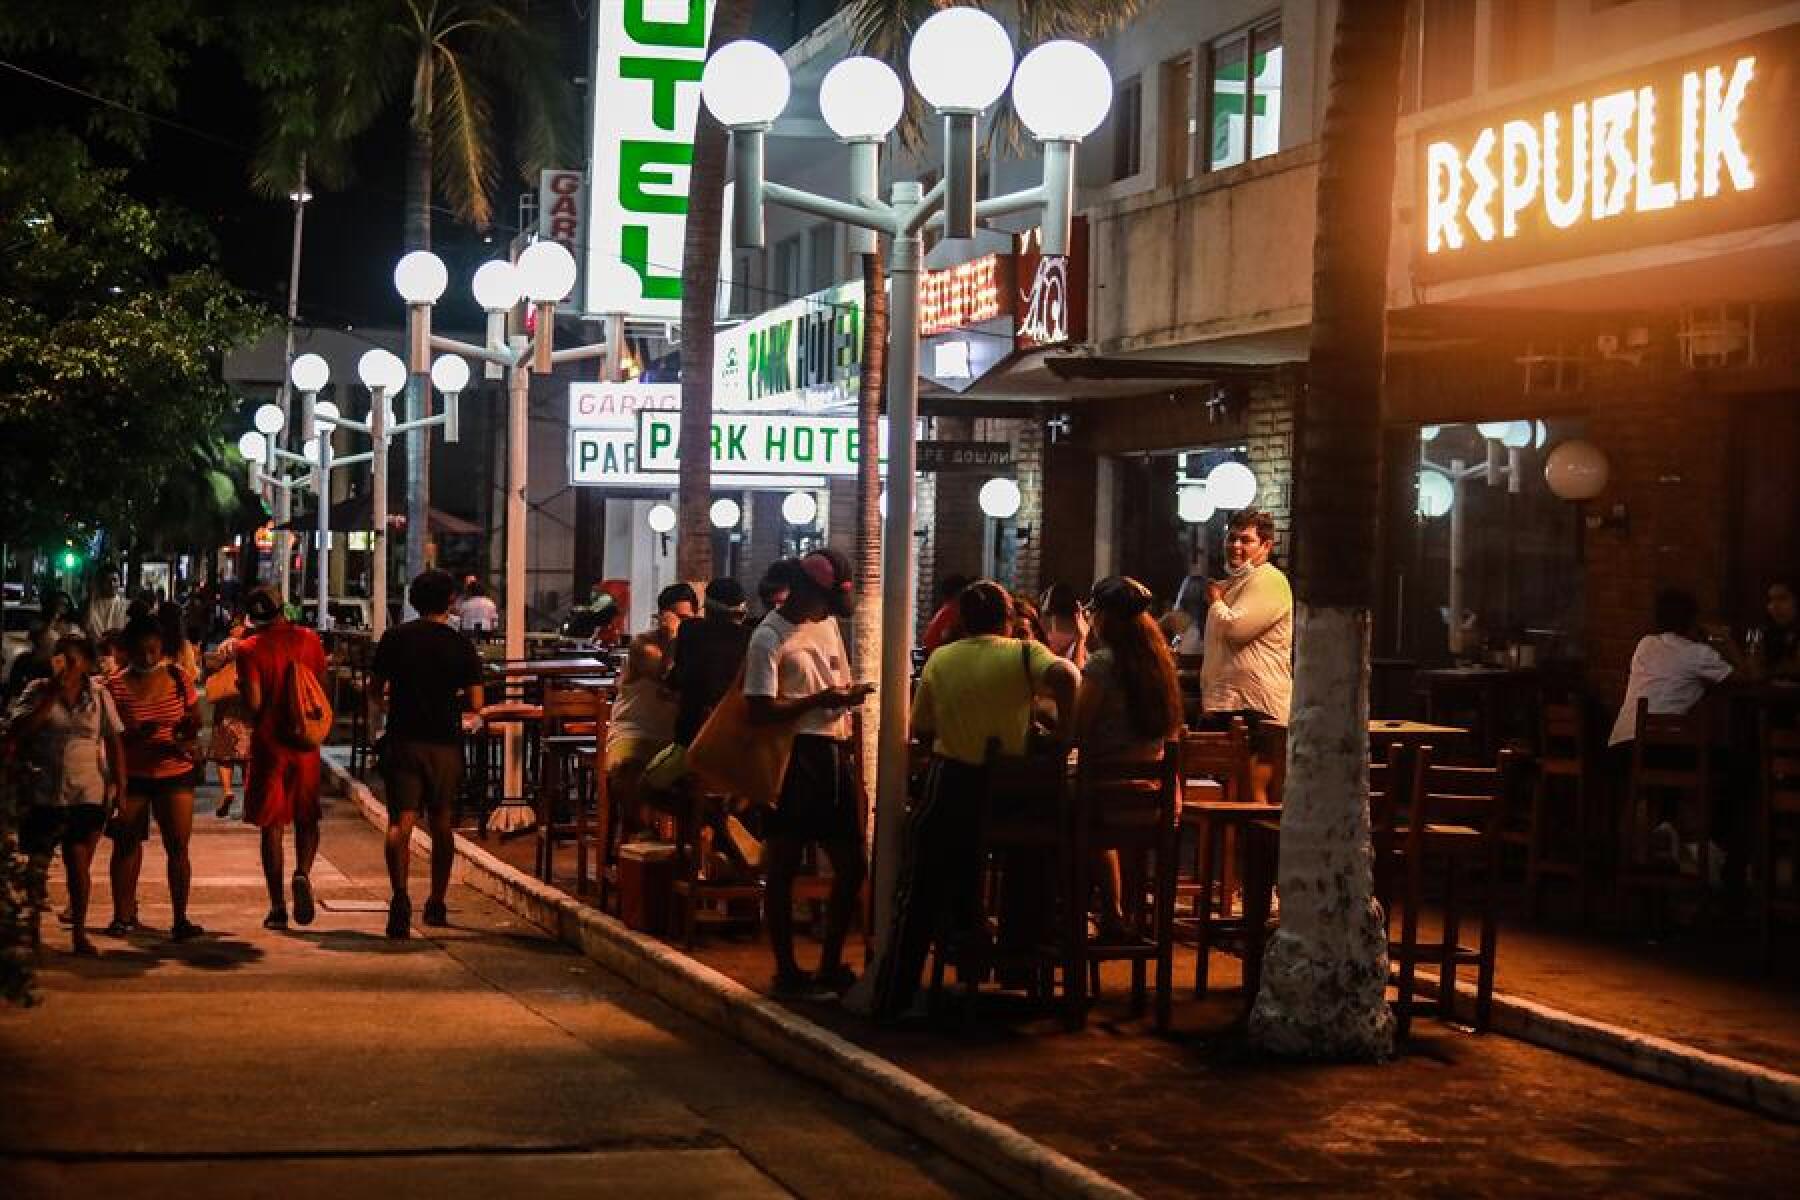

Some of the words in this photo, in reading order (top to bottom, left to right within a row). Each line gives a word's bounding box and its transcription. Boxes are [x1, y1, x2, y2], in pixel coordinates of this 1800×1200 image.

[1426, 55, 1757, 255] REPUBLIK
[649, 421, 748, 462] PRK
[764, 424, 888, 463] HOTE
